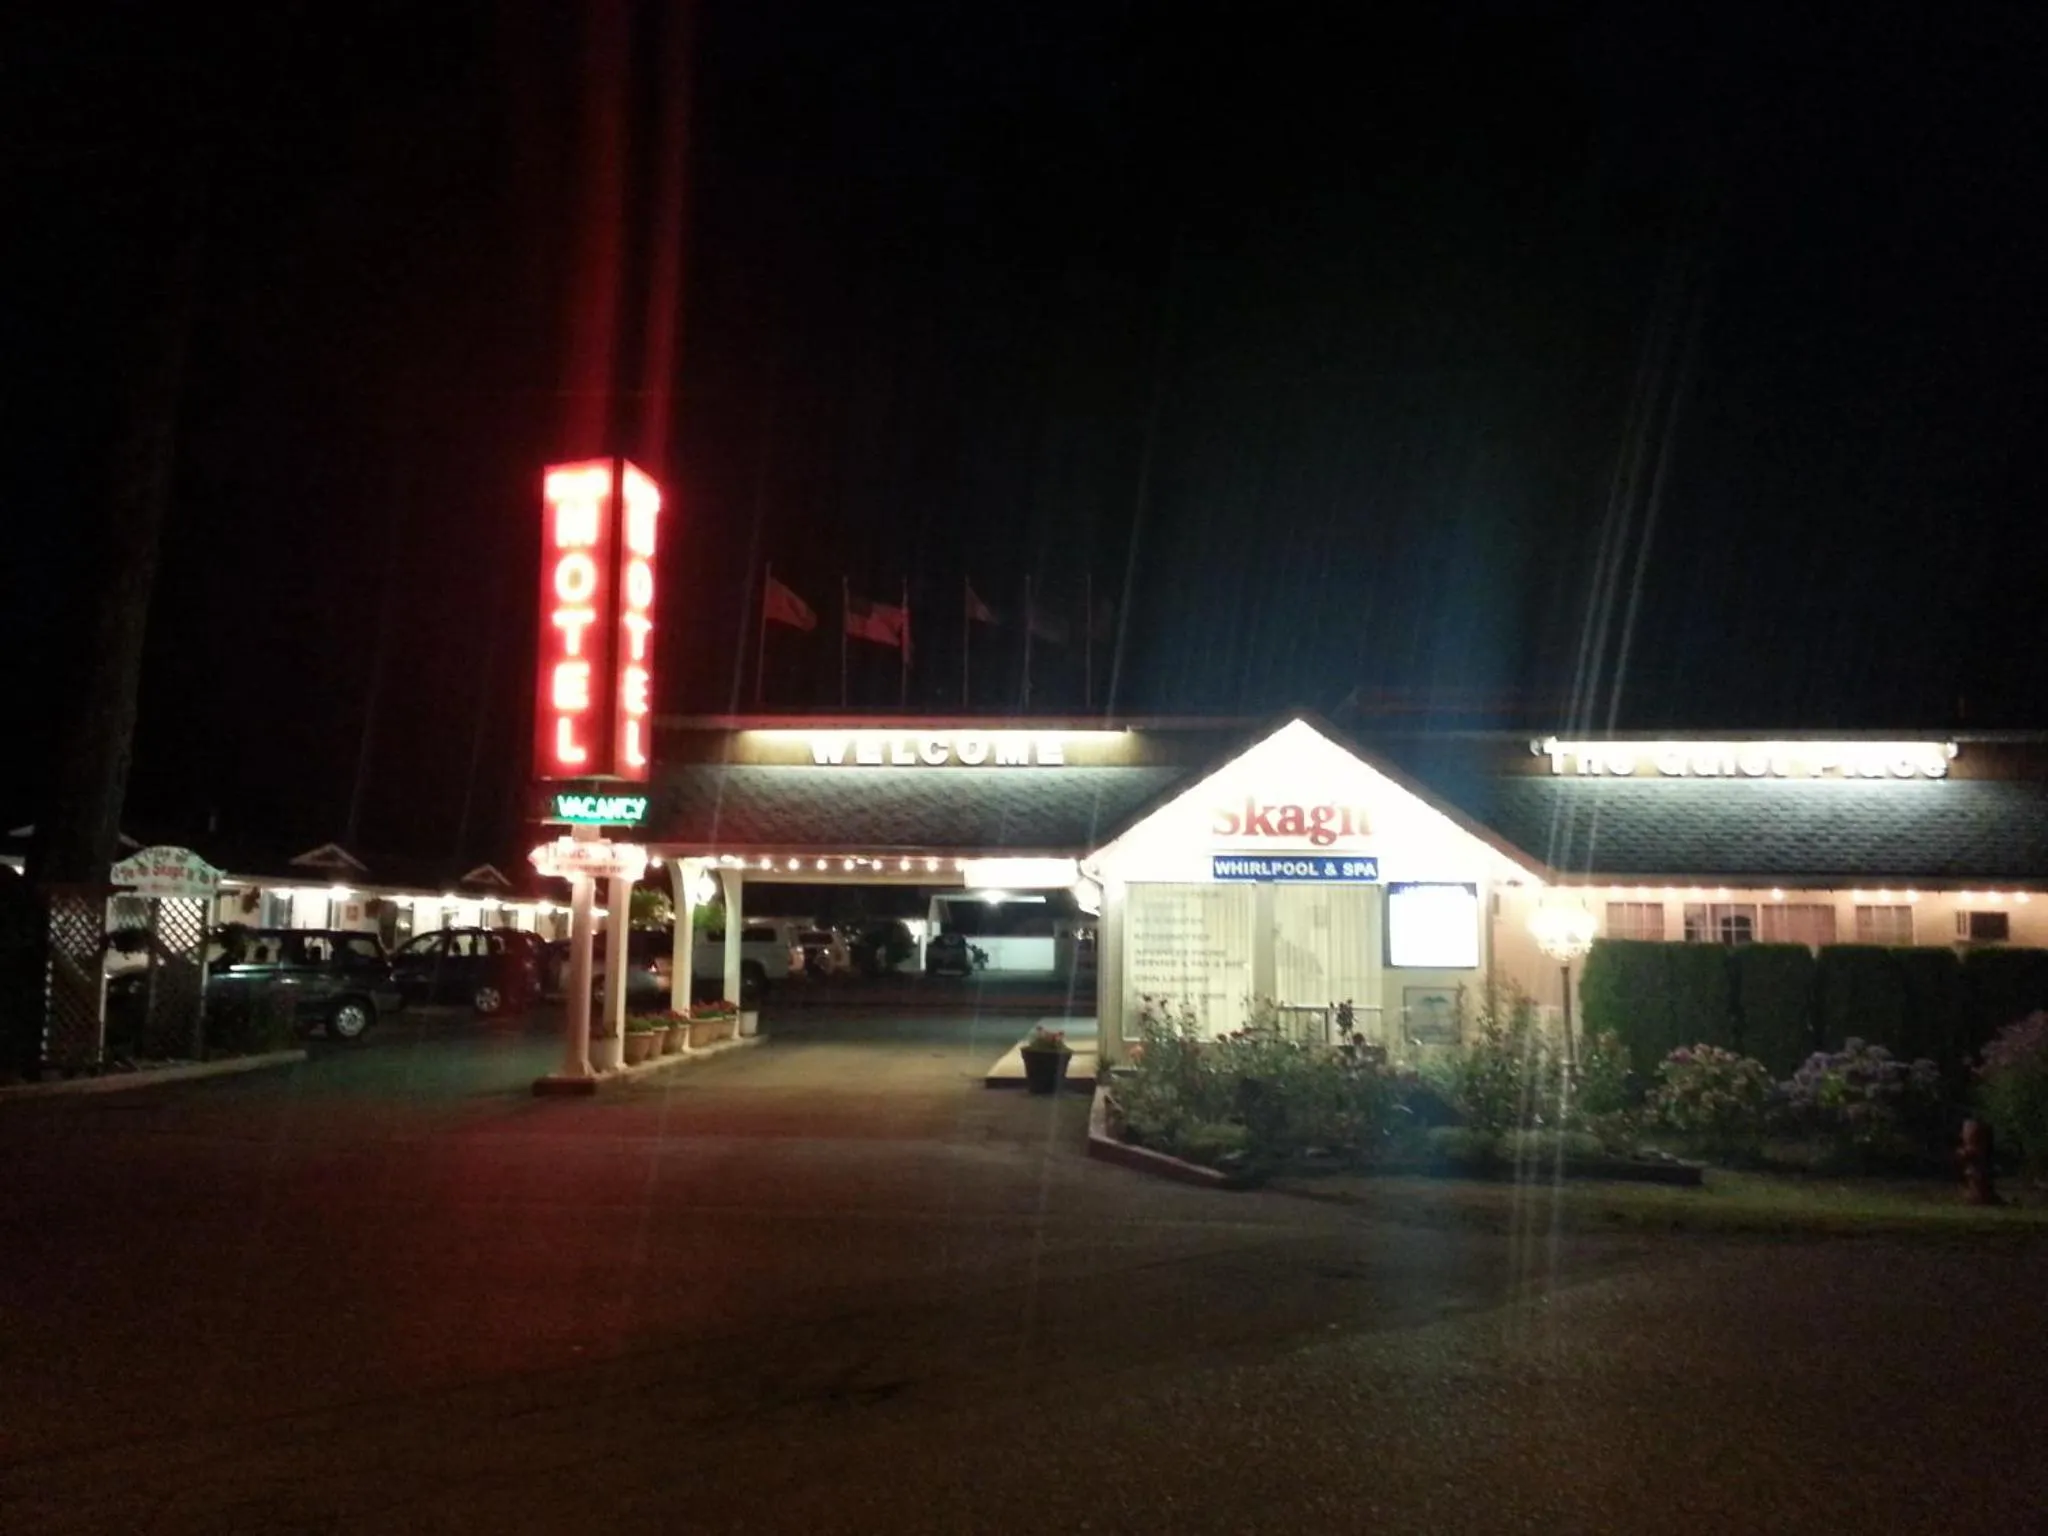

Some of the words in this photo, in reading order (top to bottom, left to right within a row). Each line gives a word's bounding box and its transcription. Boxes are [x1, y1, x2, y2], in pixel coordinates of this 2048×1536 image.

[810, 735, 1065, 767] WELCOME
[556, 795, 647, 820] VACANCY
[1212, 796, 1373, 847] Skagit
[1214, 860, 1319, 876] WHIRLPOOL
[1323, 862, 1338, 877] &
[1342, 862, 1377, 877] SPA
